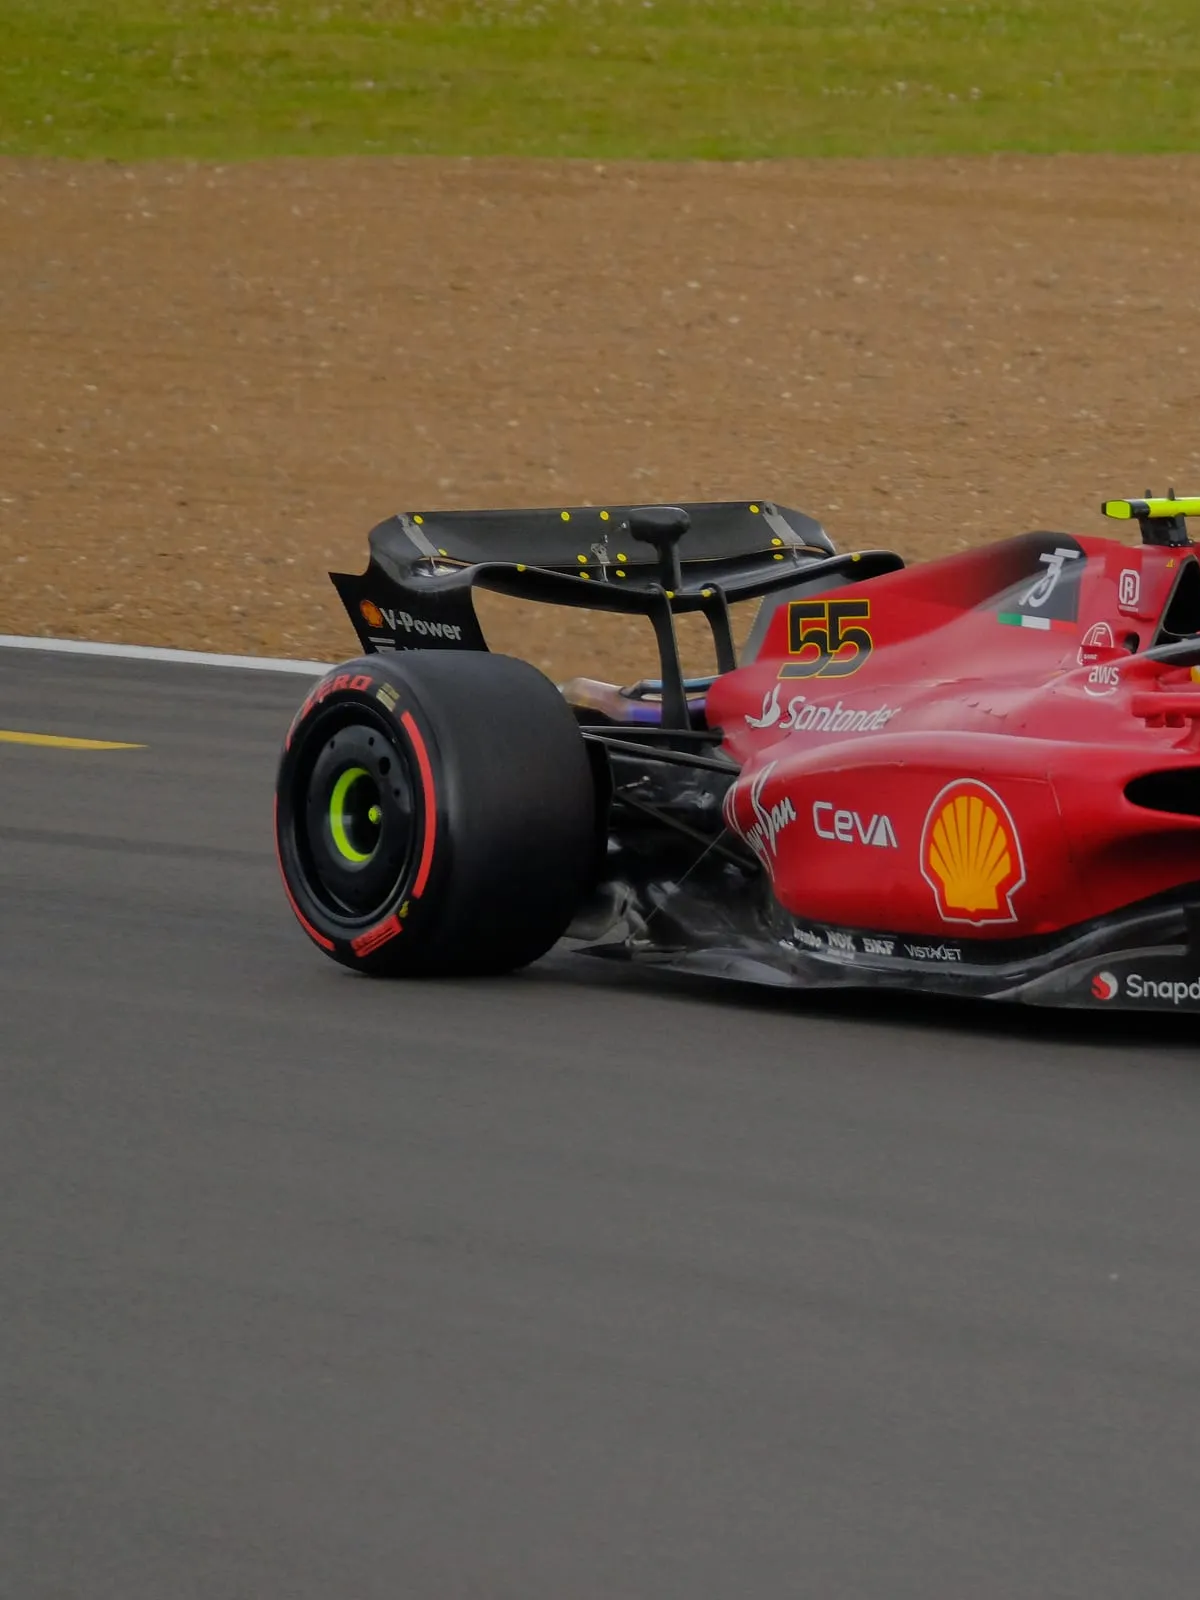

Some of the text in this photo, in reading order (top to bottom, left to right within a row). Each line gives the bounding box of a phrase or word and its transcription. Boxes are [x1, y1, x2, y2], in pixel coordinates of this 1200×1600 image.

[378, 607, 462, 641] V-Power
[777, 599, 874, 681] 55
[1088, 664, 1120, 686] aws
[779, 696, 903, 733] Santander
